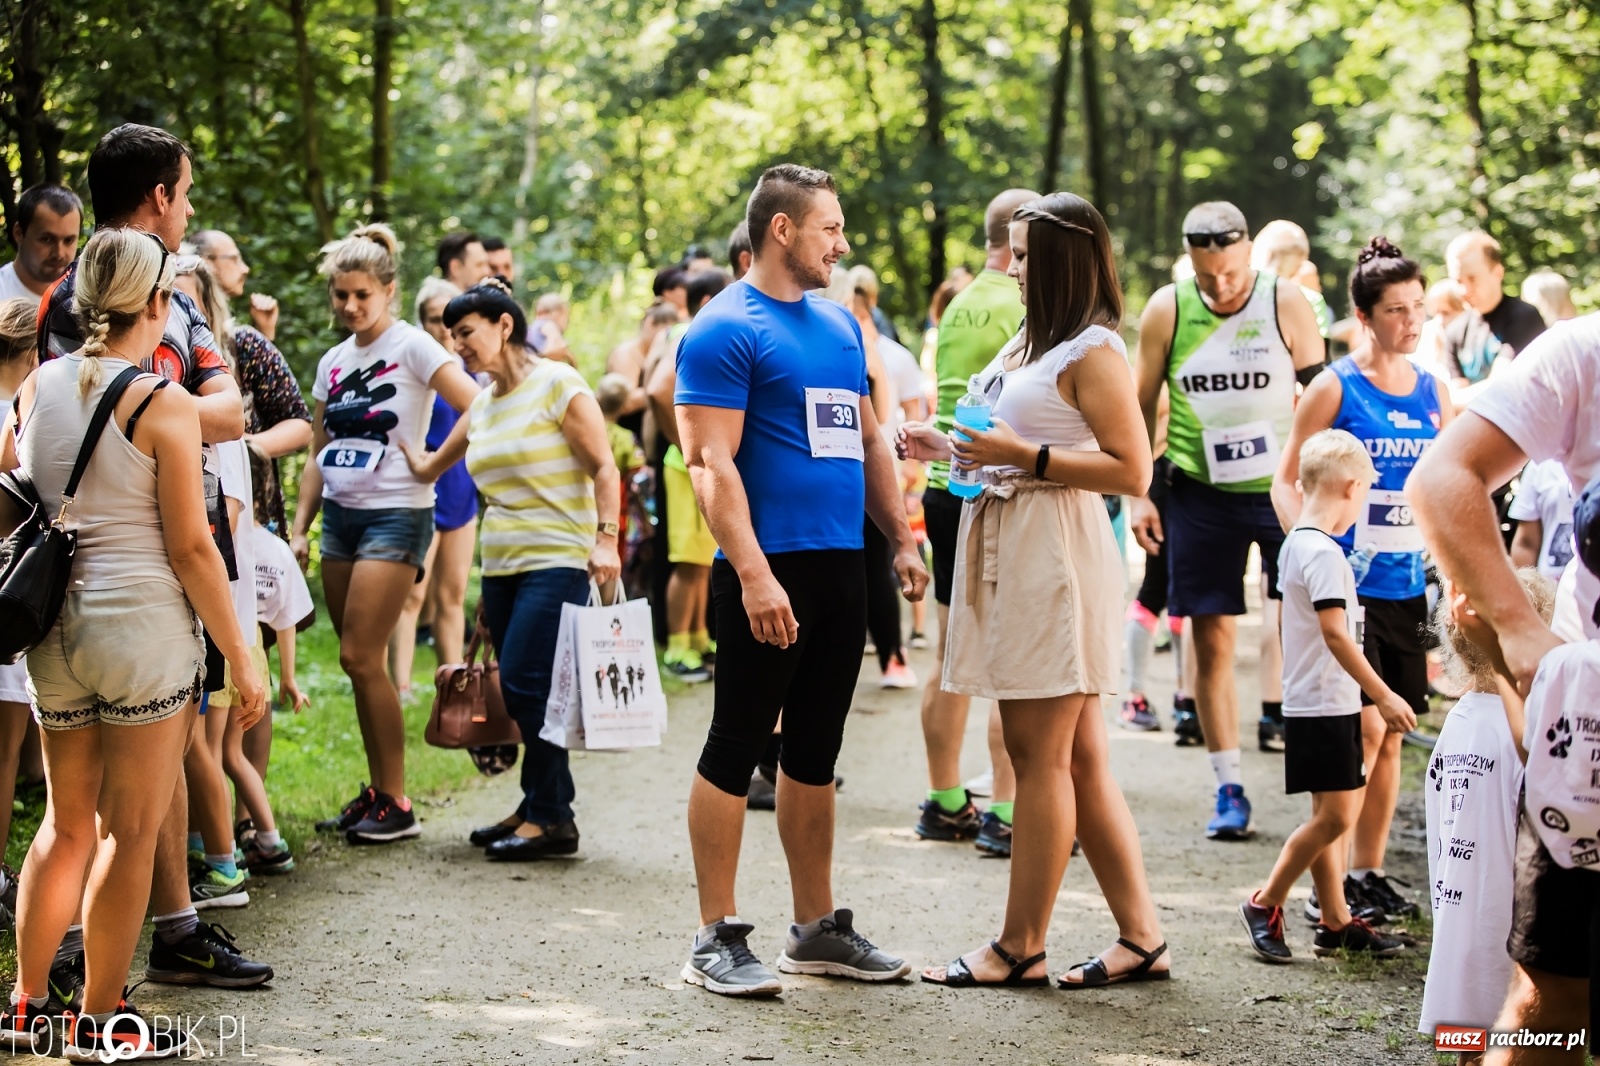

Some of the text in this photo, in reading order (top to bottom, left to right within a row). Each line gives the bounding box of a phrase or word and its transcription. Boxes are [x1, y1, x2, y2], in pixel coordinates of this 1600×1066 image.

[831, 405, 853, 426] 39
[335, 450, 357, 466] 63
[1227, 440, 1256, 459] 70
[1385, 505, 1413, 526] 49
